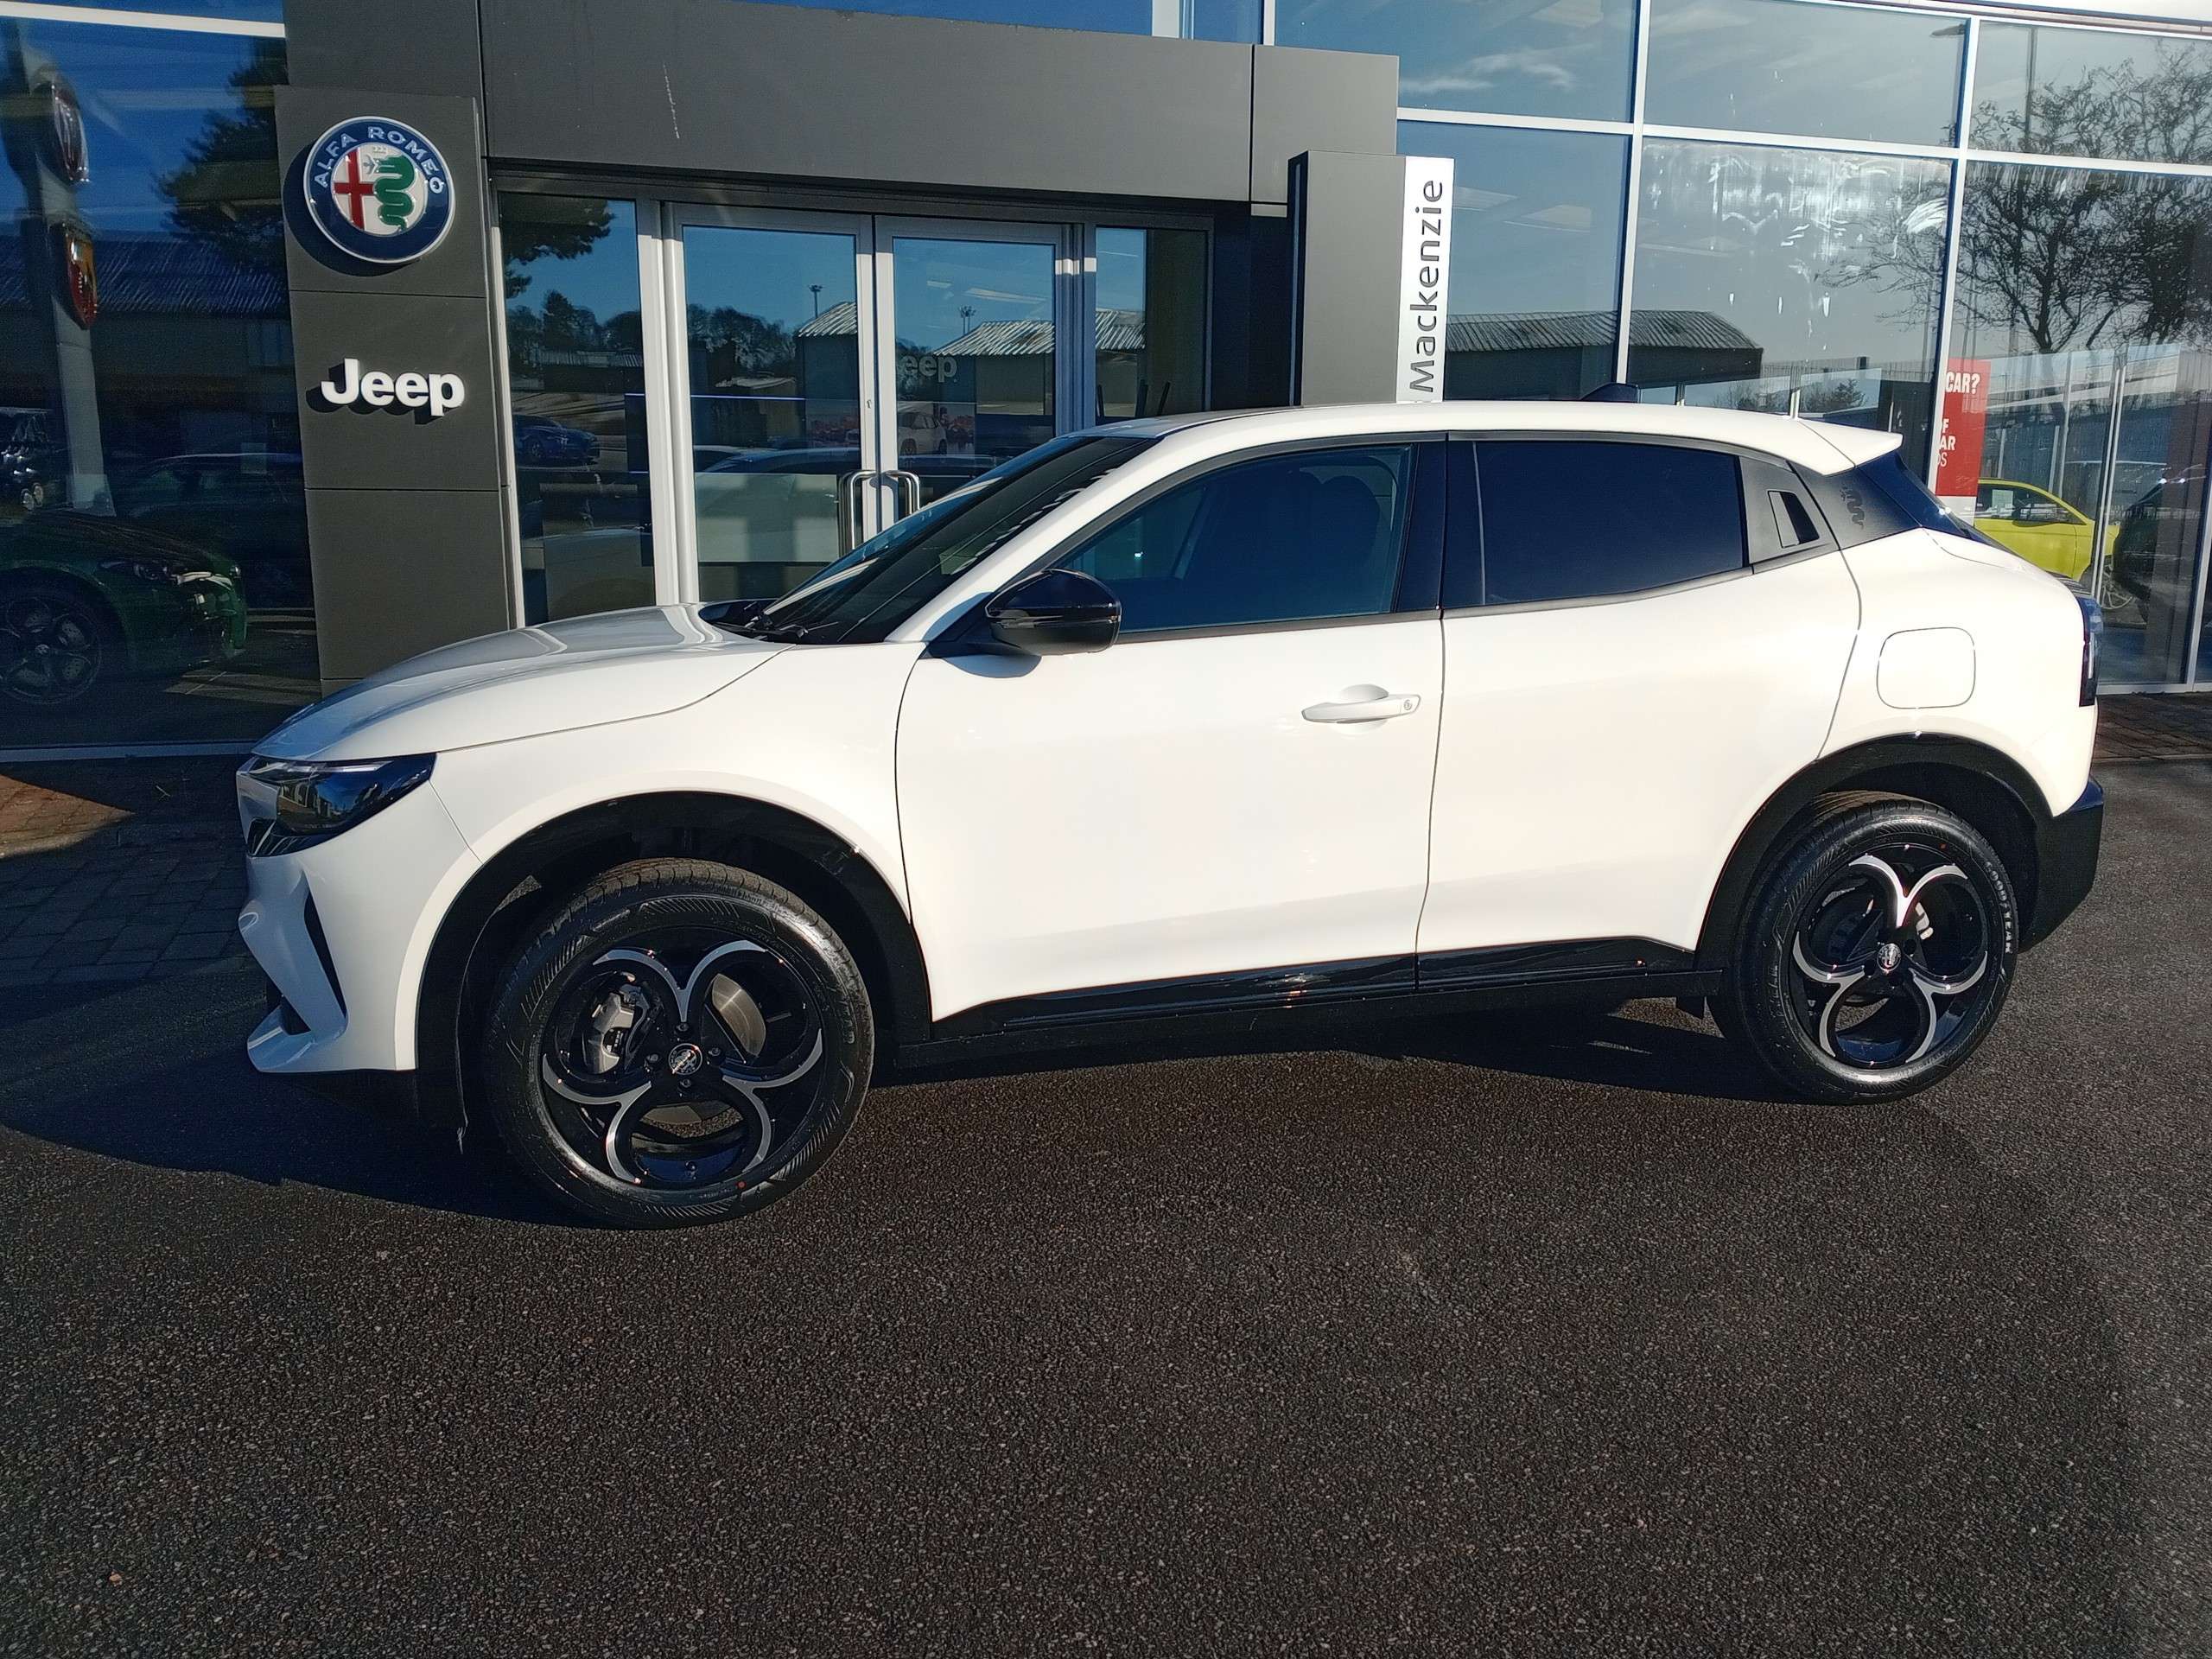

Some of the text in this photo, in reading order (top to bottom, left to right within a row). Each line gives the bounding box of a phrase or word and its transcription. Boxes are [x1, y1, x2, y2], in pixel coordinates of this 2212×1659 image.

[314, 126, 445, 194] ALFA ROMEO
[1409, 180, 1442, 392] Mackenzie
[321, 358, 465, 416] Jeep
[898, 355, 957, 383] eep
[1946, 372, 1980, 394] CAR?
[1940, 435, 1956, 451] AR
